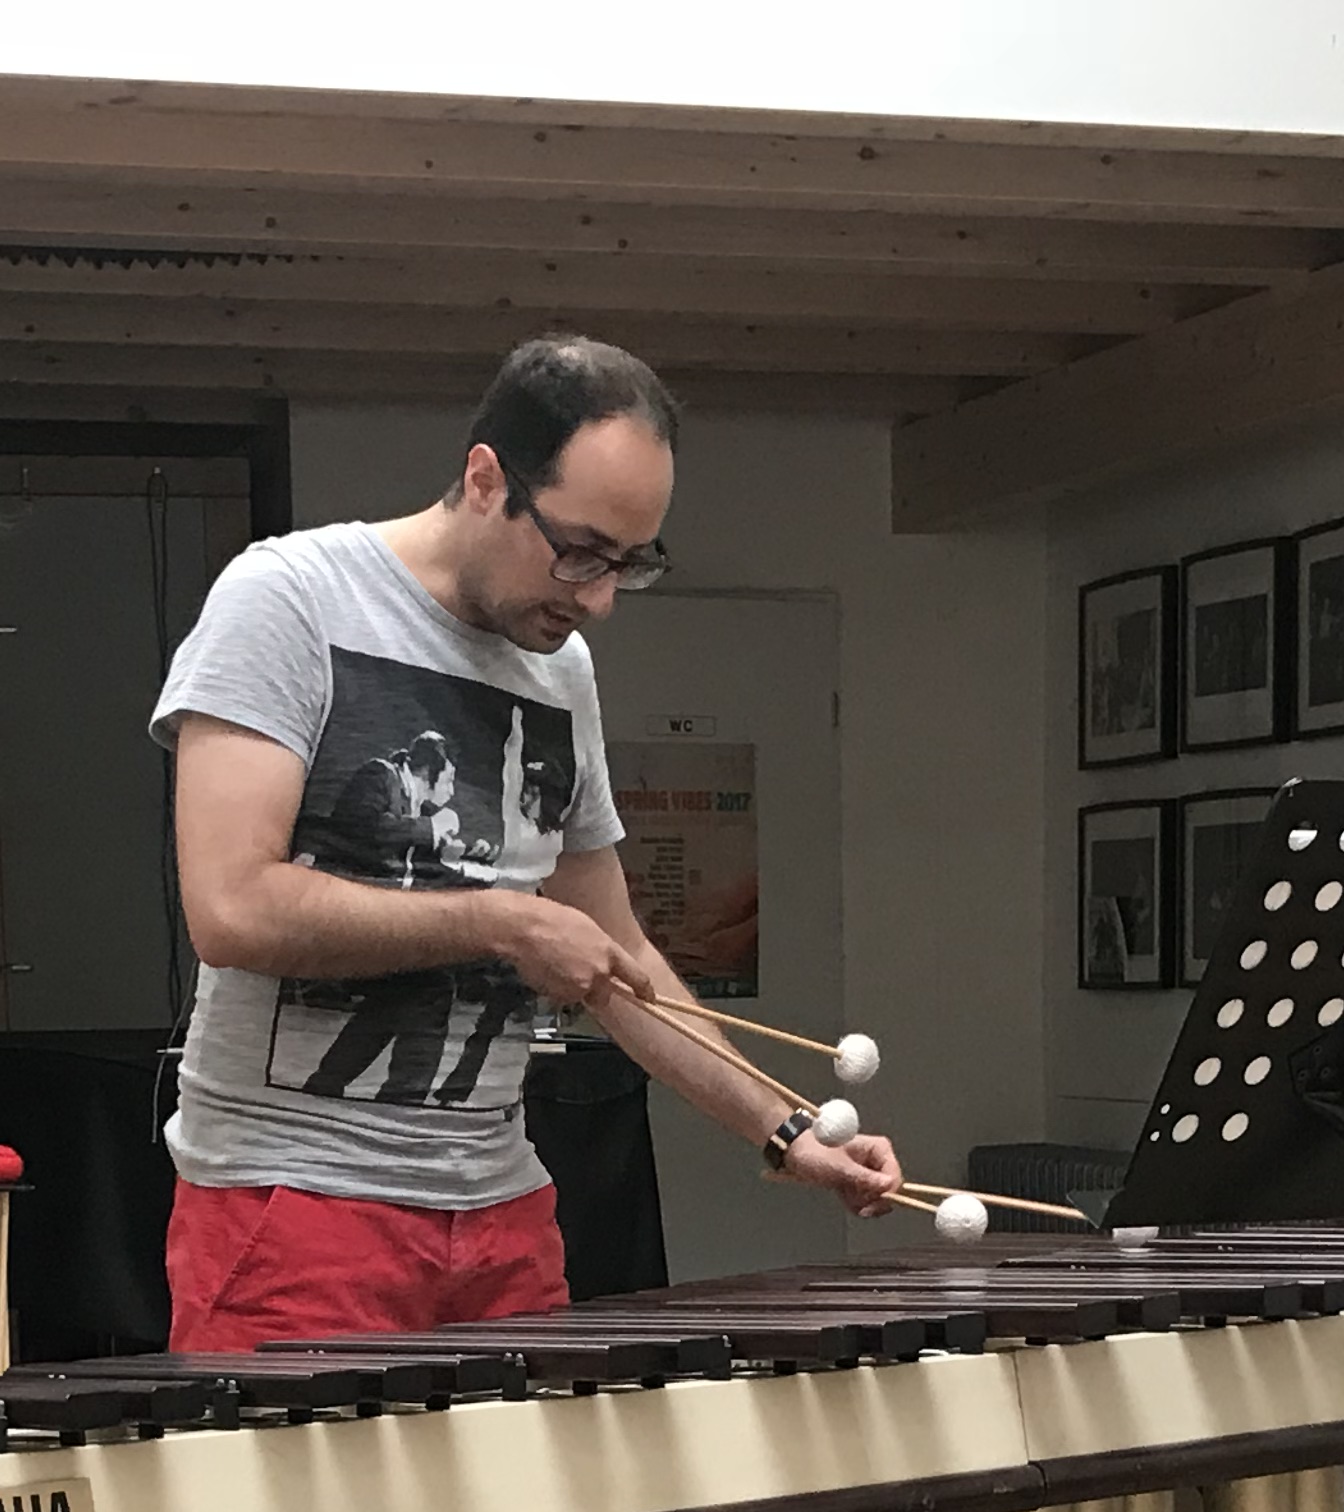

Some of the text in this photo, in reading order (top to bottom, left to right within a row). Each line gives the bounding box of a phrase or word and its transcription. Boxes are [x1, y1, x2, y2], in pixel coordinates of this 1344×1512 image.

[669, 719, 693, 733] WC
[671, 790, 712, 812] VIBES
[716, 791, 751, 812] 2017
